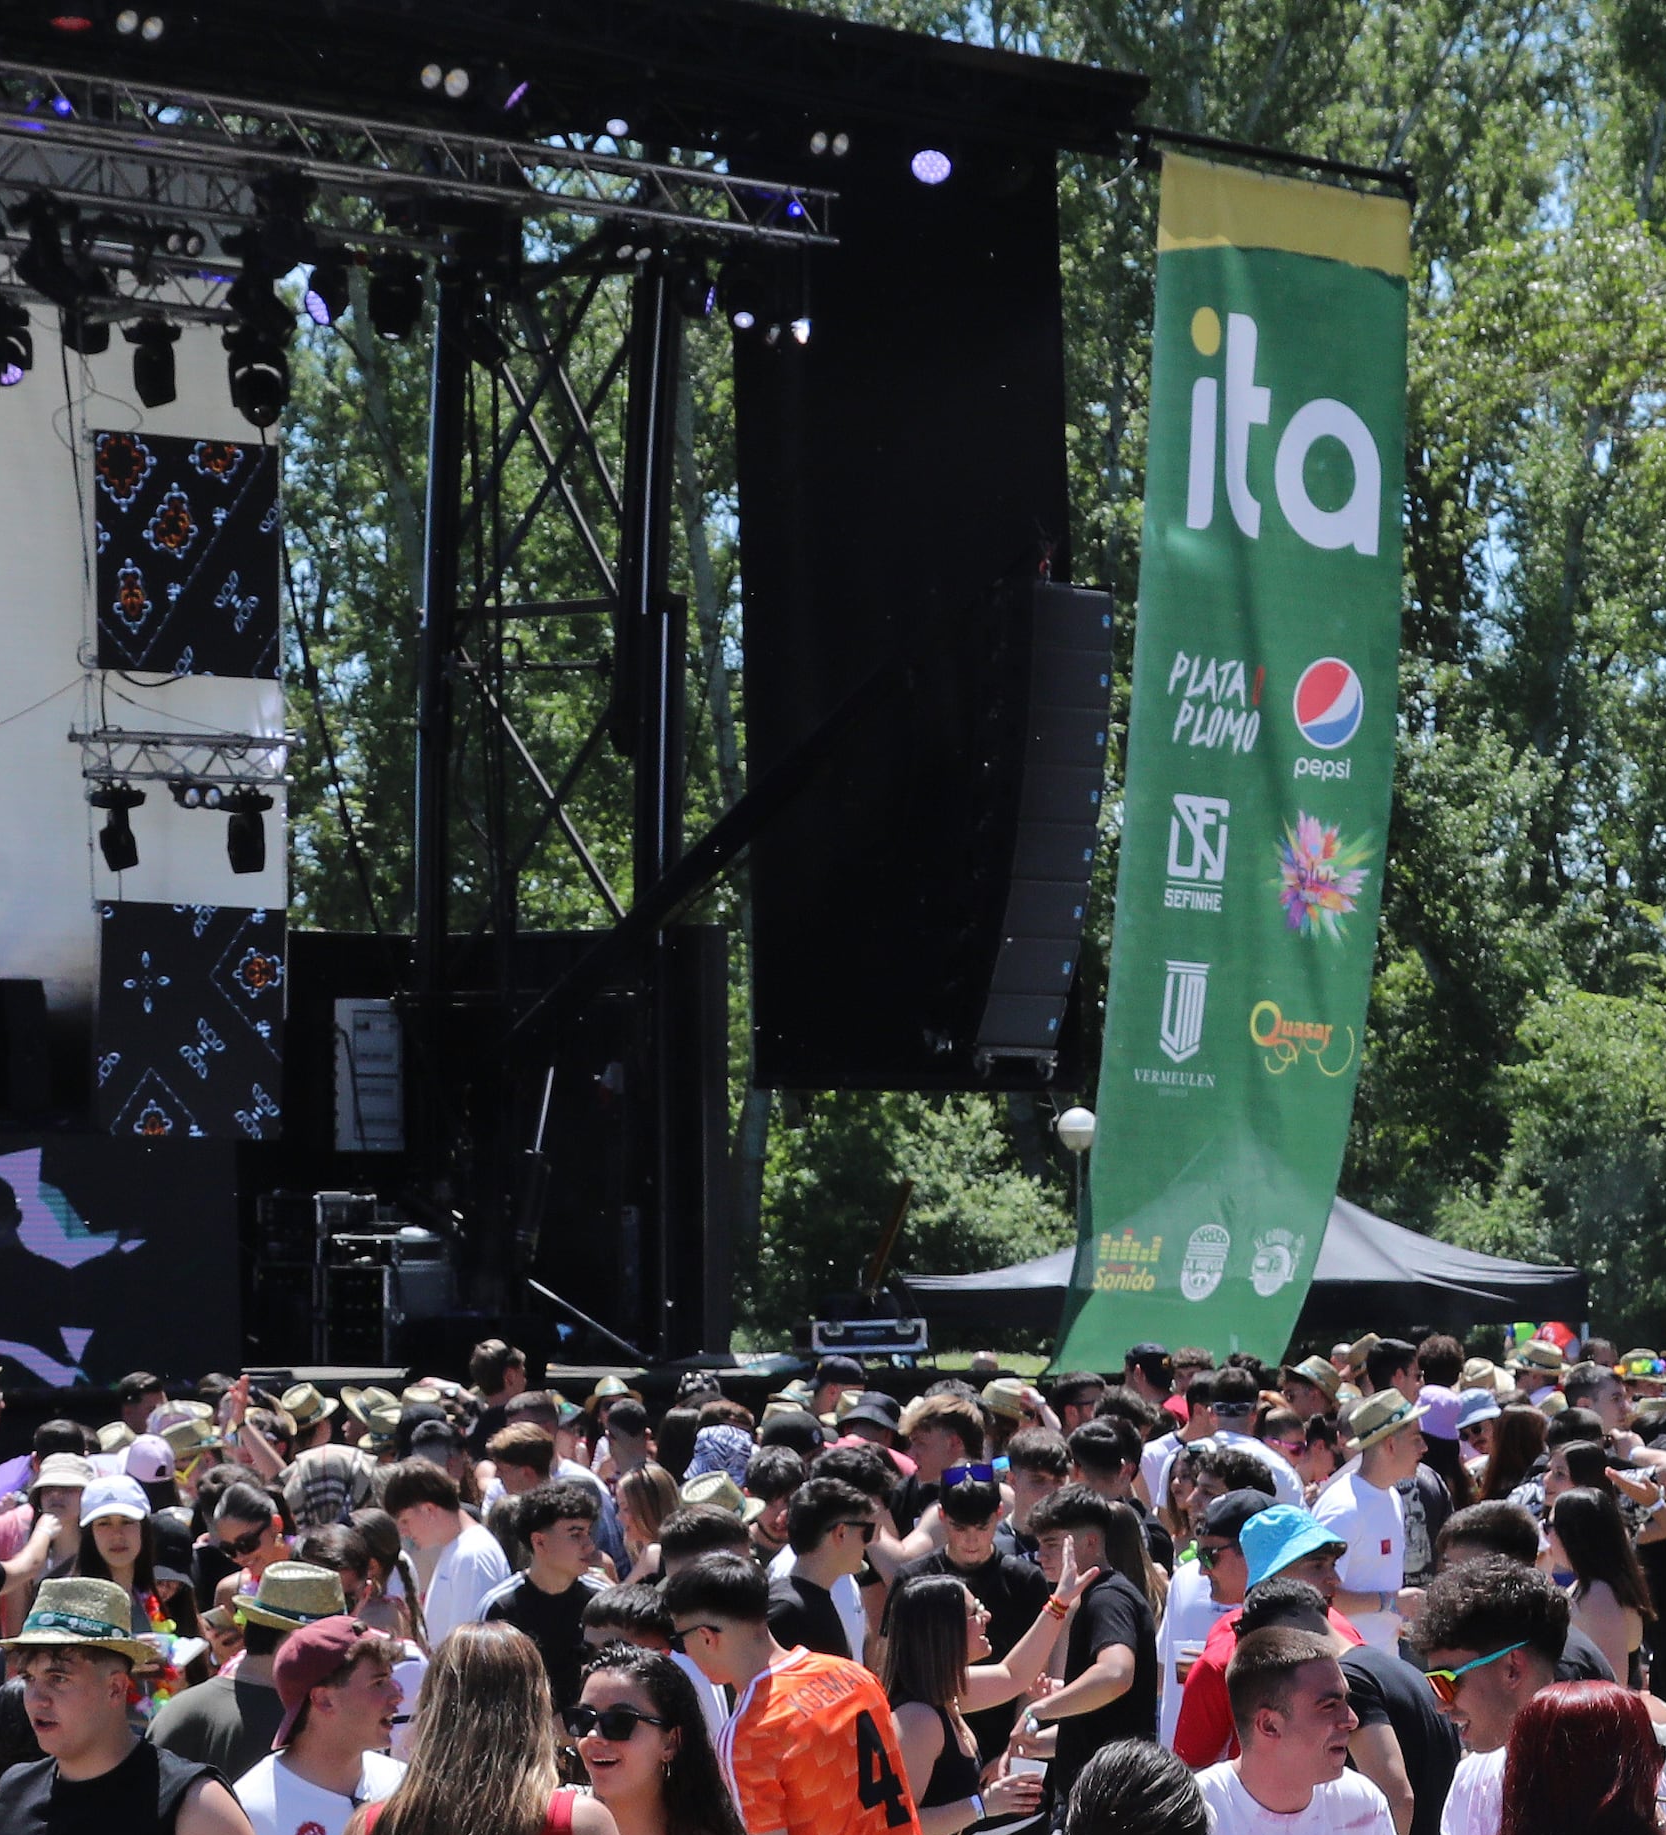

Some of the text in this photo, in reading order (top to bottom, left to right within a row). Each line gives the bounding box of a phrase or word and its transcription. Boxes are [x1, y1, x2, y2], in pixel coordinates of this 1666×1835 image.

[1186, 306, 1382, 557] ita
[1166, 650, 1247, 708] PLATA
[1172, 698, 1261, 756] PLOMO
[1293, 756, 1352, 781] pepsi
[1163, 888, 1224, 912] SEFINHE
[1250, 1000, 1341, 1064] Quasar
[1133, 1067, 1216, 1087] VERMEULEN
[1092, 1265, 1156, 1291] Sonido
[787, 1662, 874, 1719] KOEMAN
[856, 1709, 911, 1828] 4
